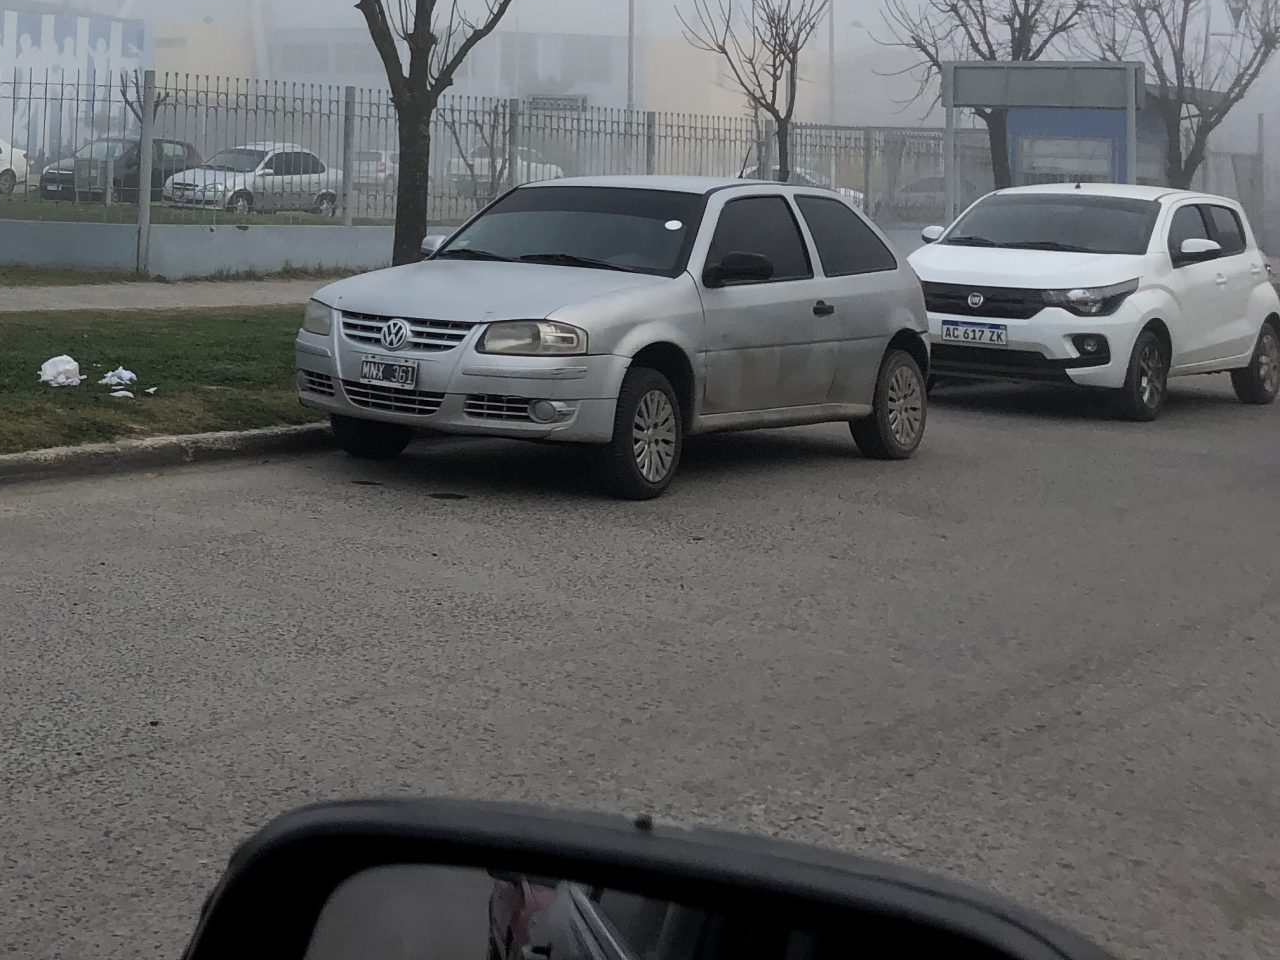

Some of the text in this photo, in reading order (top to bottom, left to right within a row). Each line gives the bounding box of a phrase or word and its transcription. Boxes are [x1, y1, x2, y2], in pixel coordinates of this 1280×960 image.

[945, 327, 1003, 343] AC 617 ZK
[362, 361, 413, 384] MNX 361
